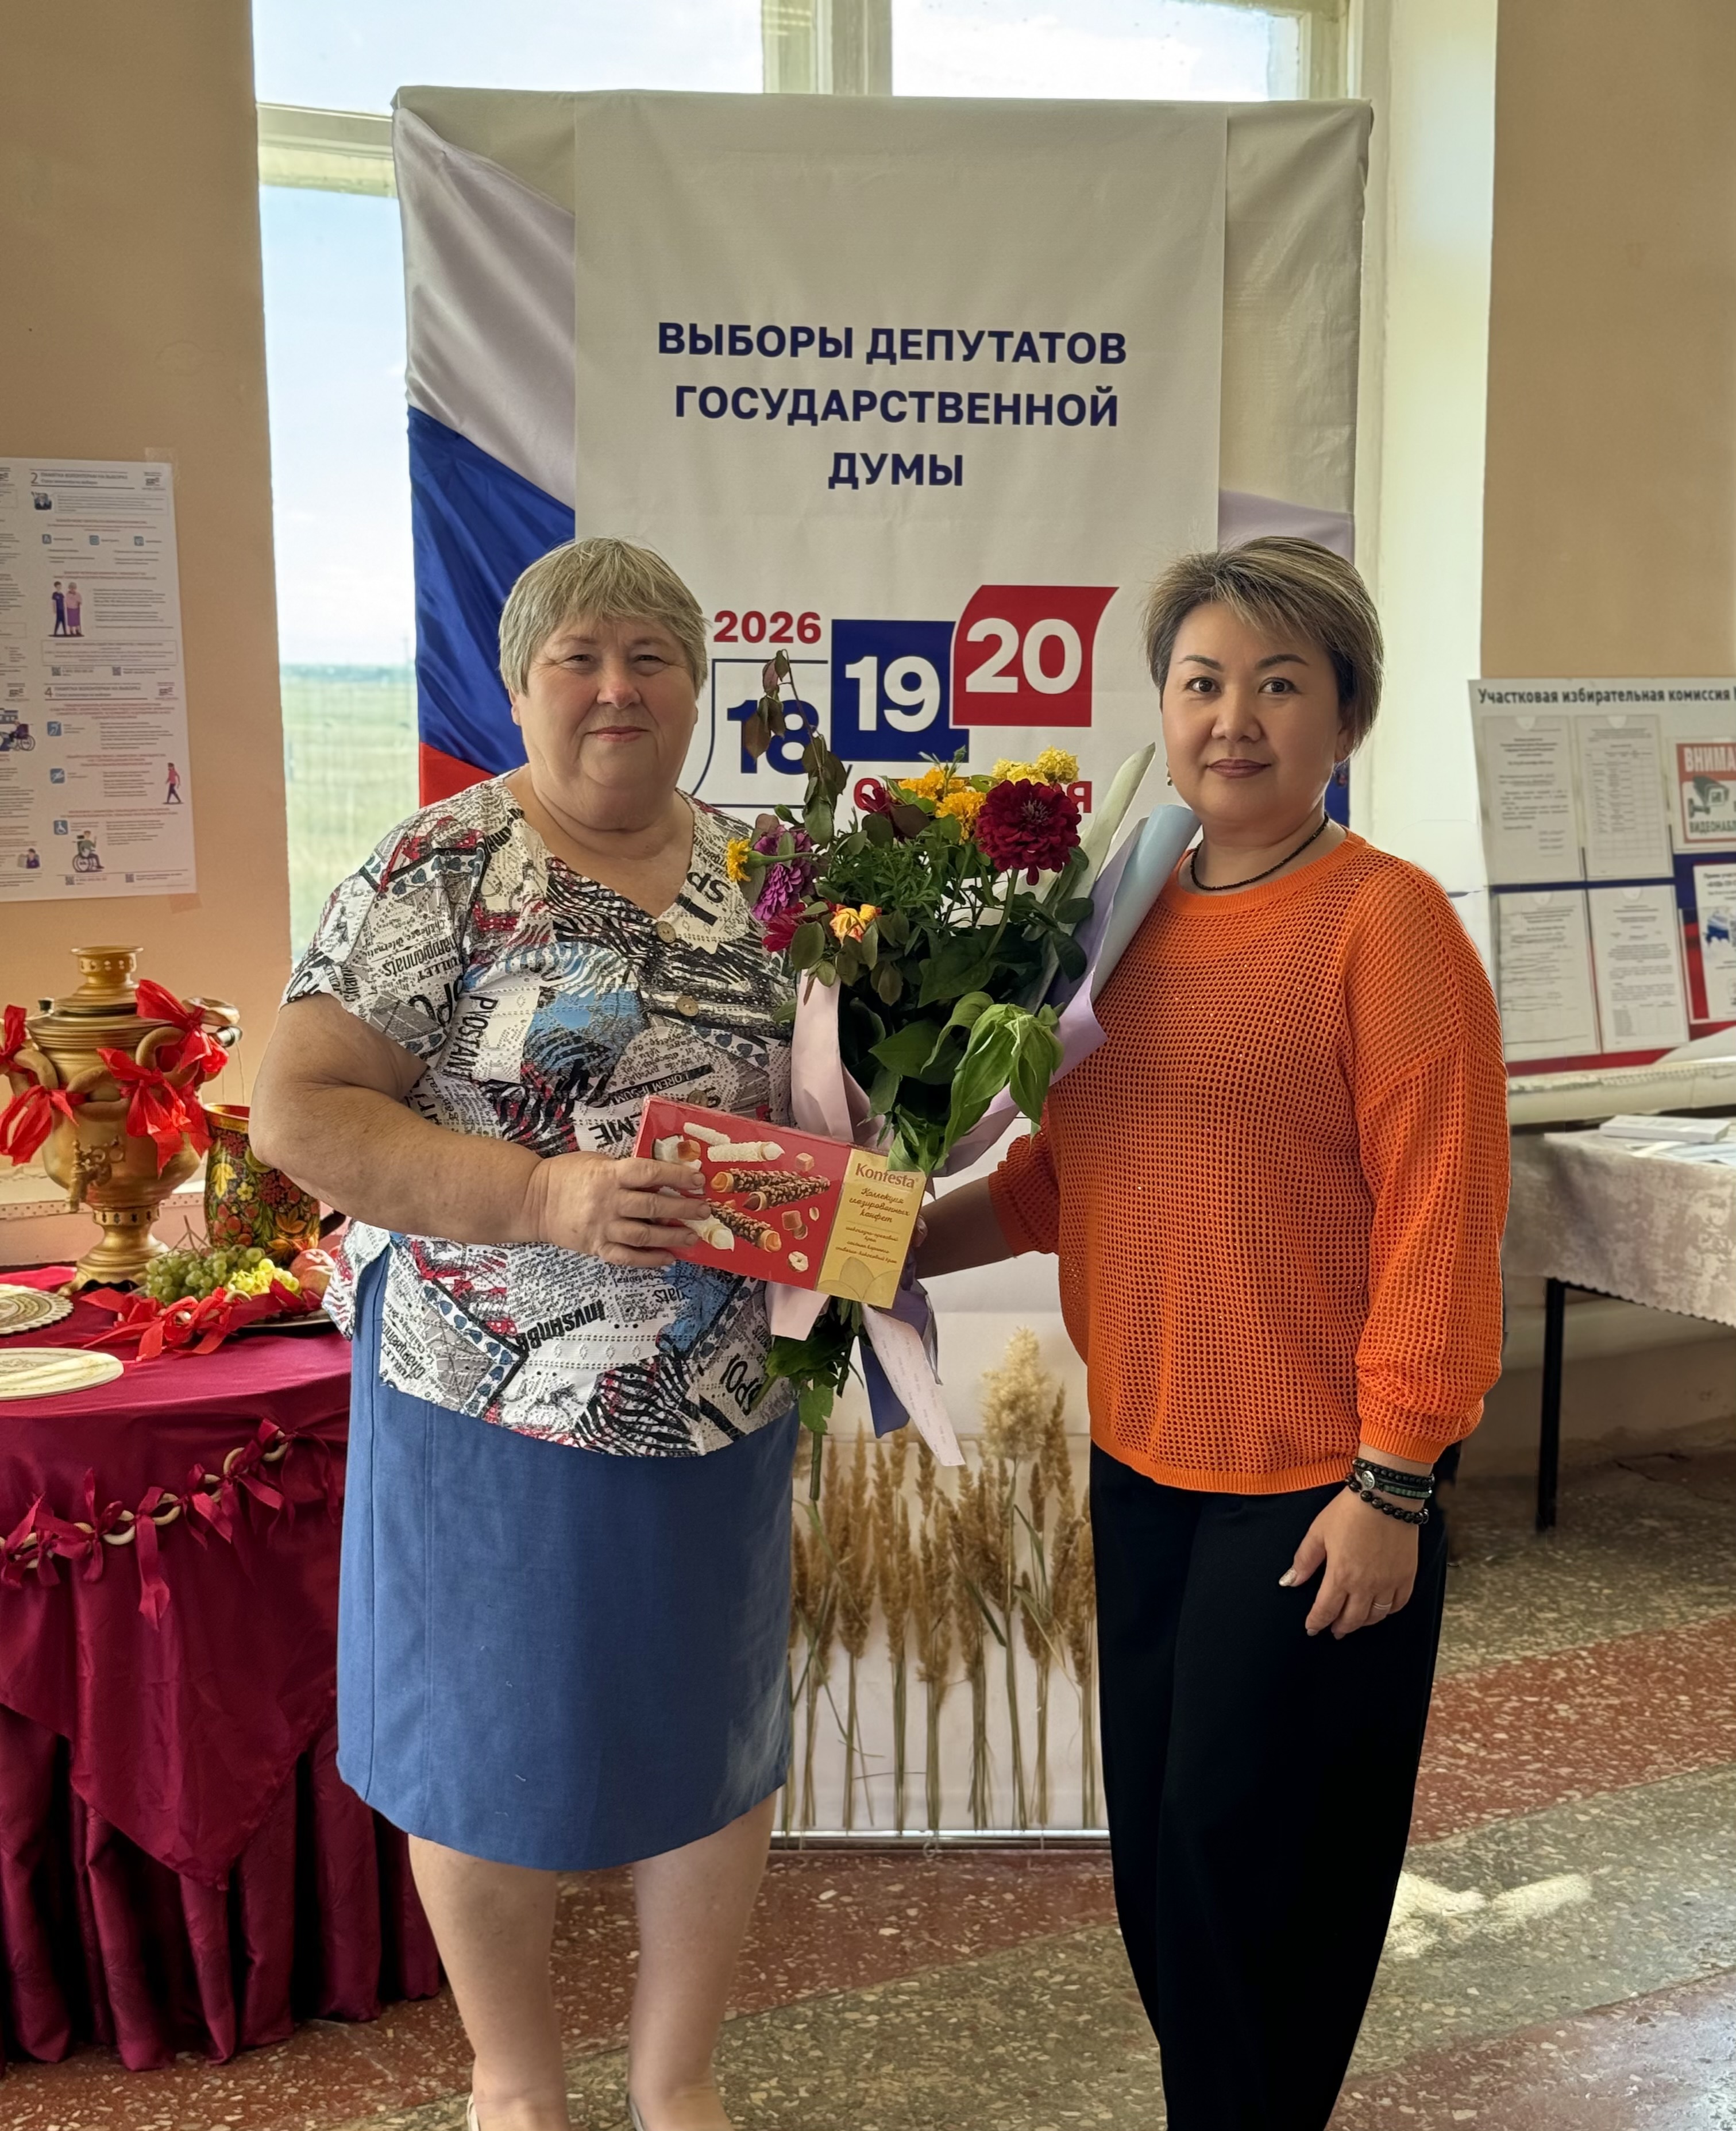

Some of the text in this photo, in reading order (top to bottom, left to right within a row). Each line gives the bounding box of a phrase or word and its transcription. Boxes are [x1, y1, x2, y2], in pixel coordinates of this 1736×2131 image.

[658, 322, 1127, 366] ВЫБОРЫ ДЕПУТАТОВ
[676, 385, 1118, 427] ГОСУДАРСТВЕННОЙ
[828, 452, 963, 490] ДУМЫ
[713, 610, 822, 644] 2026
[965, 617, 1082, 695] 20
[845, 655, 941, 733] 19
[1478, 688, 1558, 705] Участковая
[1561, 687, 1665, 706] избирательная
[1668, 687, 1731, 702] комиссия
[726, 699, 820, 775] 18
[1684, 746, 1736, 773] ВНИМА
[652, 1072, 689, 1091] LOREM
[855, 1163, 915, 1189] Konfesta
